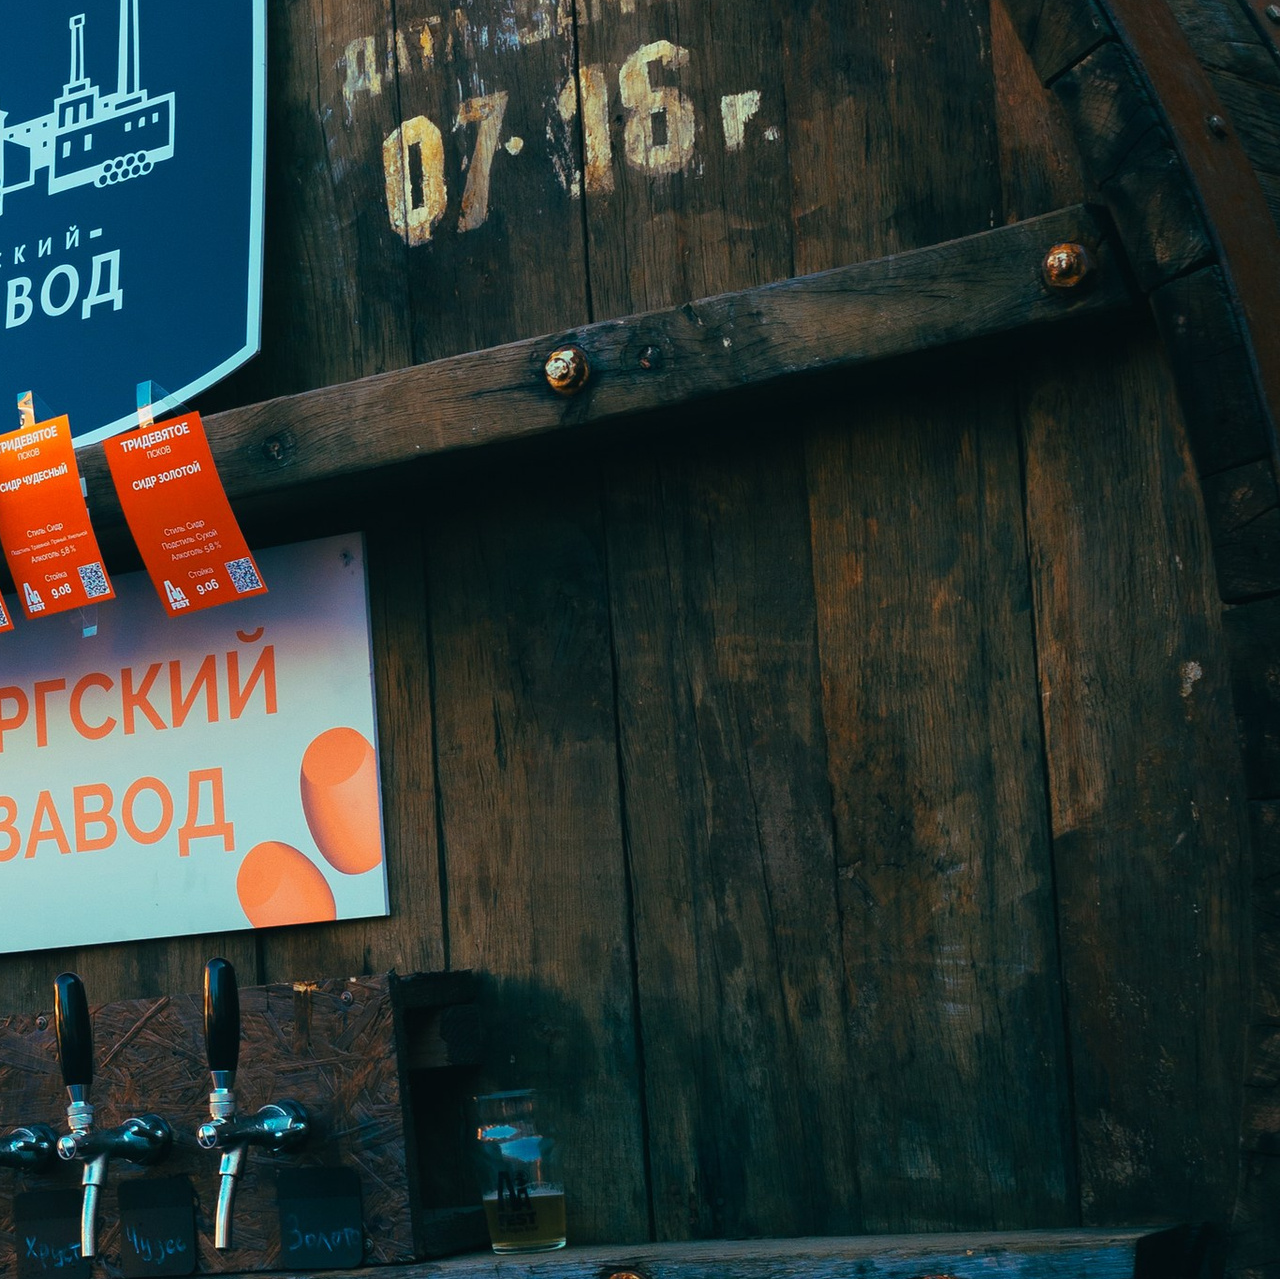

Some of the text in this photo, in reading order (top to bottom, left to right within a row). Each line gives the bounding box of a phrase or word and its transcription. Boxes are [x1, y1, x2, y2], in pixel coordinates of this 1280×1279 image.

[120, 422, 190, 453] ТРИДЕВЯТОЕ
[17, 447, 40, 461] ПСКОВ
[147, 445, 172, 459] ПСКОВ
[0, 462, 68, 493] СИДР ЧУДЕСНЫЙ
[132, 460, 202, 491] СИДР ЗОЛОТОЙ
[46, 522, 64, 532] Сидр
[186, 519, 205, 530] Сидр
[195, 528, 218, 541] Сухой
[44, 571, 68, 582] Стойка
[188, 567, 214, 579] Стойка
[51, 583, 72, 599] 9.08
[196, 579, 219, 595] 9.06
